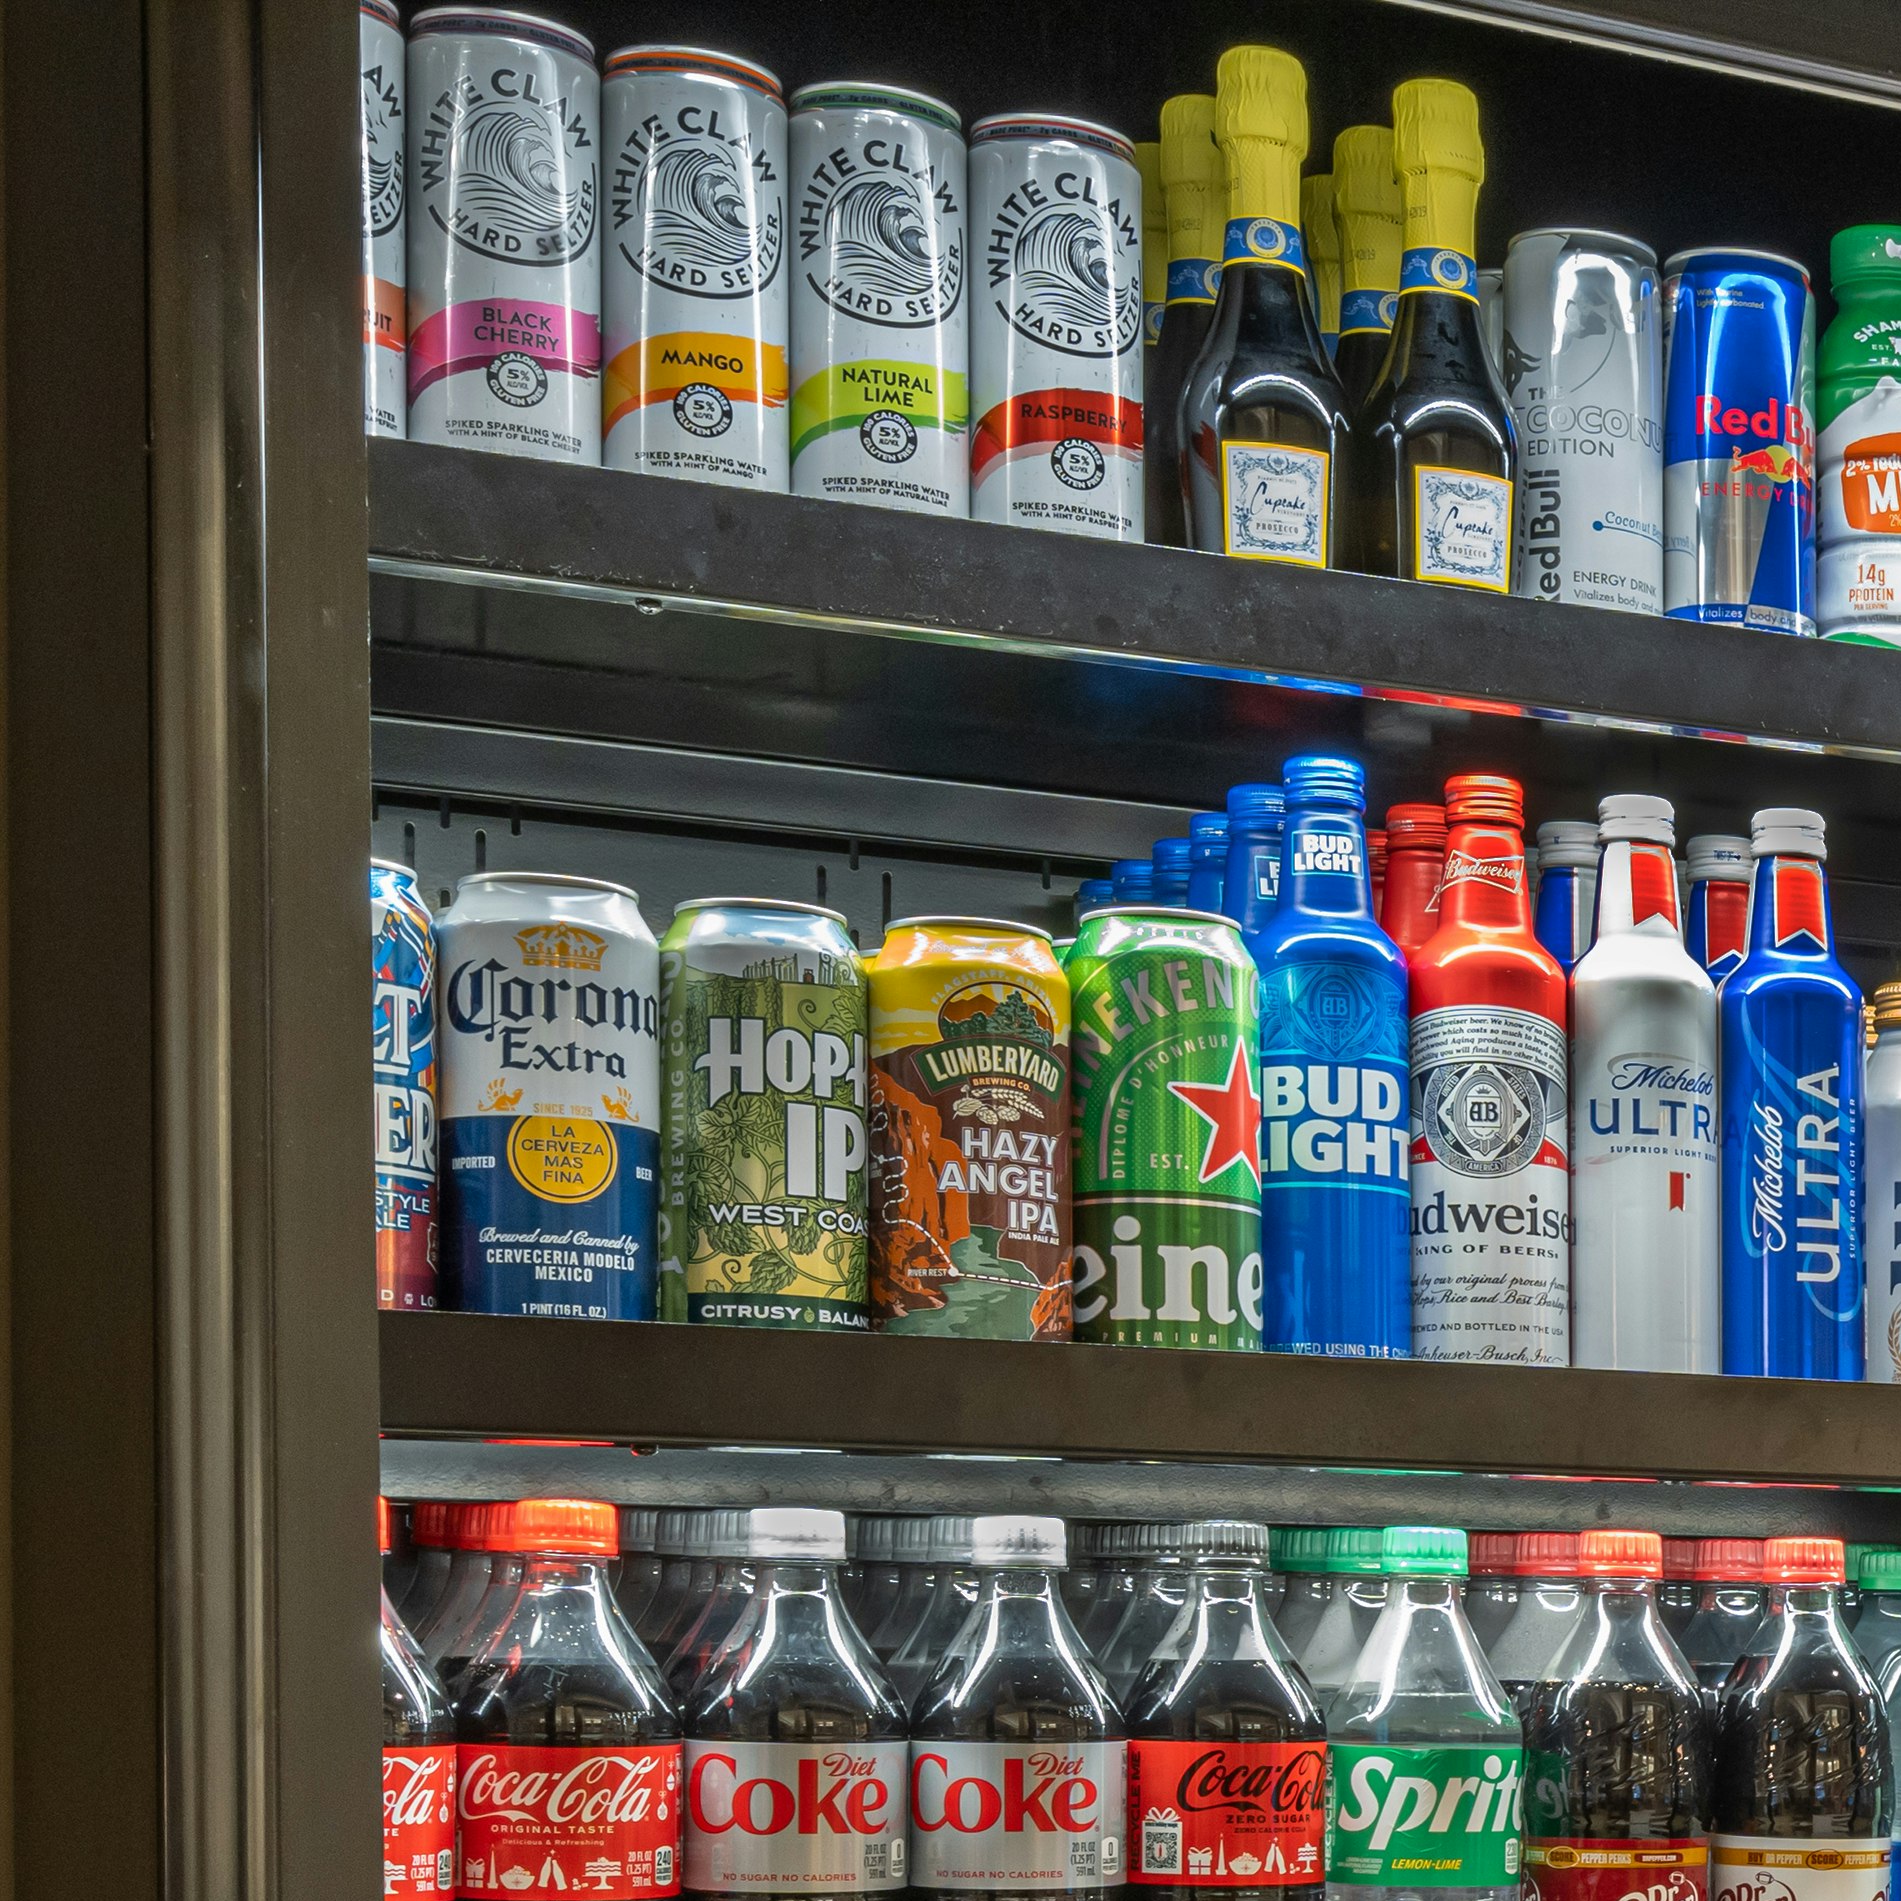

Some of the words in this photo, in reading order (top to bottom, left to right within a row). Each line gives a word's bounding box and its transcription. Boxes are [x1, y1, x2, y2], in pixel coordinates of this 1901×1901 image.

[482, 307, 553, 333] BLACK
[473, 325, 560, 353] CHERRY
[661, 349, 744, 374] MANGO
[841, 367, 934, 395] NATURAL
[863, 387, 915, 408] LIME
[1021, 403, 1128, 434] RASPBERRY
[1696, 395, 1778, 439] Red
[1528, 440, 1614, 459] EDITION
[1701, 482, 1783, 503] ENERGY
[1256, 522, 1299, 534] PROSECCO
[1857, 563, 1886, 587] 14g
[1848, 588, 1895, 602] PROTEIN
[1302, 831, 1353, 855] BUD
[1293, 849, 1362, 877] LIGHT
[447, 958, 660, 1043] Corona
[500, 1028, 627, 1080] Extra
[1611, 1062, 1714, 1097] Michelob
[1262, 1065, 1401, 1121] BUD
[534, 1103, 564, 1115] SINCE
[570, 1104, 593, 1116] 1925
[551, 1125, 575, 1138] LA
[521, 1139, 604, 1156] CERVEZA
[962, 1126, 1061, 1167] HAZY
[1609, 1144, 1669, 1156] SUPERIOR
[452, 1156, 495, 1169] IMPORTED
[636, 1166, 653, 1182] BEER
[544, 1156, 583, 1168] MAS
[1797, 1066, 1841, 1282] ULTRA
[543, 1171, 584, 1184] FINA
[937, 1160, 1059, 1203] ANGEL
[1753, 1101, 1786, 1251] Michelob
[708, 1203, 807, 1229] WEST
[1007, 1199, 1059, 1236] IPA
[486, 1249, 578, 1265] CERVECERIA
[583, 1253, 634, 1271] MODELO
[535, 1266, 593, 1283] MEXICO
[700, 1304, 802, 1321] CITRUSY
[823, 1752, 876, 1777] Diet
[1028, 1752, 1084, 1776] Diet
[459, 1754, 660, 1823] Coca-Cola
[690, 1752, 888, 1836] Coke
[912, 1753, 1097, 1833] Coke
[491, 1824, 561, 1834] ORIGINAL
[568, 1825, 614, 1834] TASTE
[1226, 1815, 1267, 1825] ZERO
[1272, 1815, 1311, 1824] SUGAR
[1392, 1859, 1463, 1870] LEMON-LIME
[1811, 1853, 1839, 1865] SCORE
